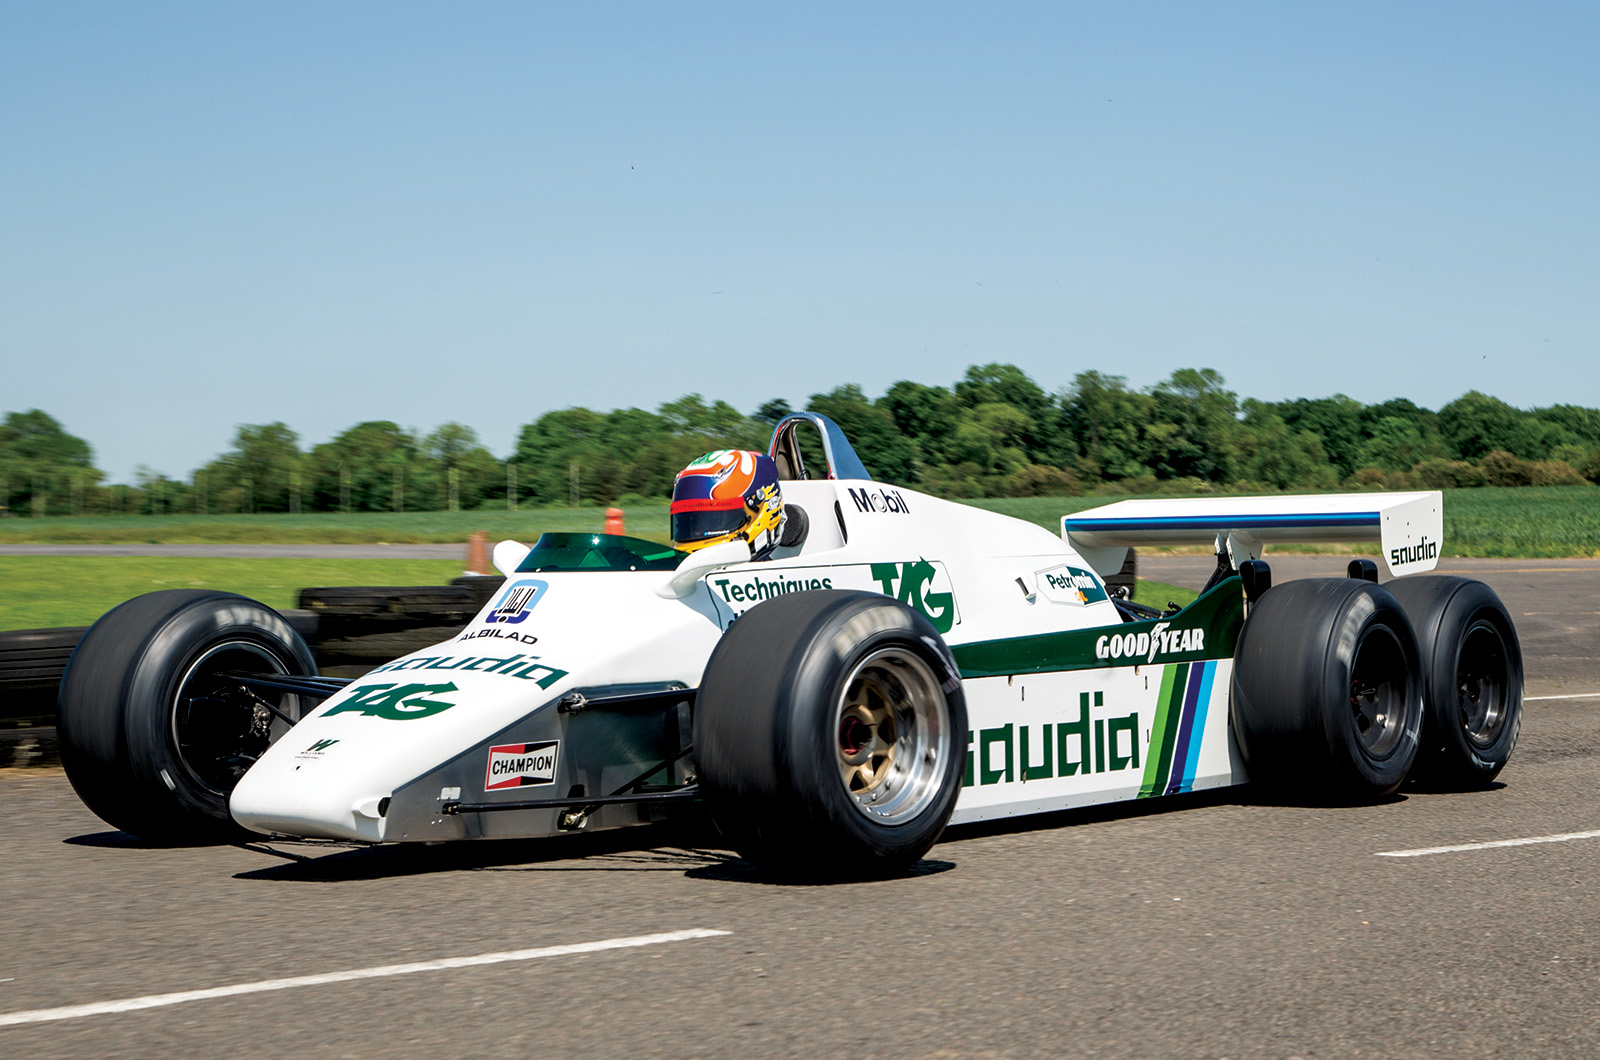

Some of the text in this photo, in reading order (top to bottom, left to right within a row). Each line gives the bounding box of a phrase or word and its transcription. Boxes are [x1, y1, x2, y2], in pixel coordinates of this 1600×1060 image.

[847, 488, 910, 514] Mobil
[1391, 536, 1436, 566] saudia
[870, 555, 954, 634] TAG
[456, 628, 539, 645] ALBILAD
[319, 681, 459, 720] TAG
[492, 755, 553, 775] CHAMPION
